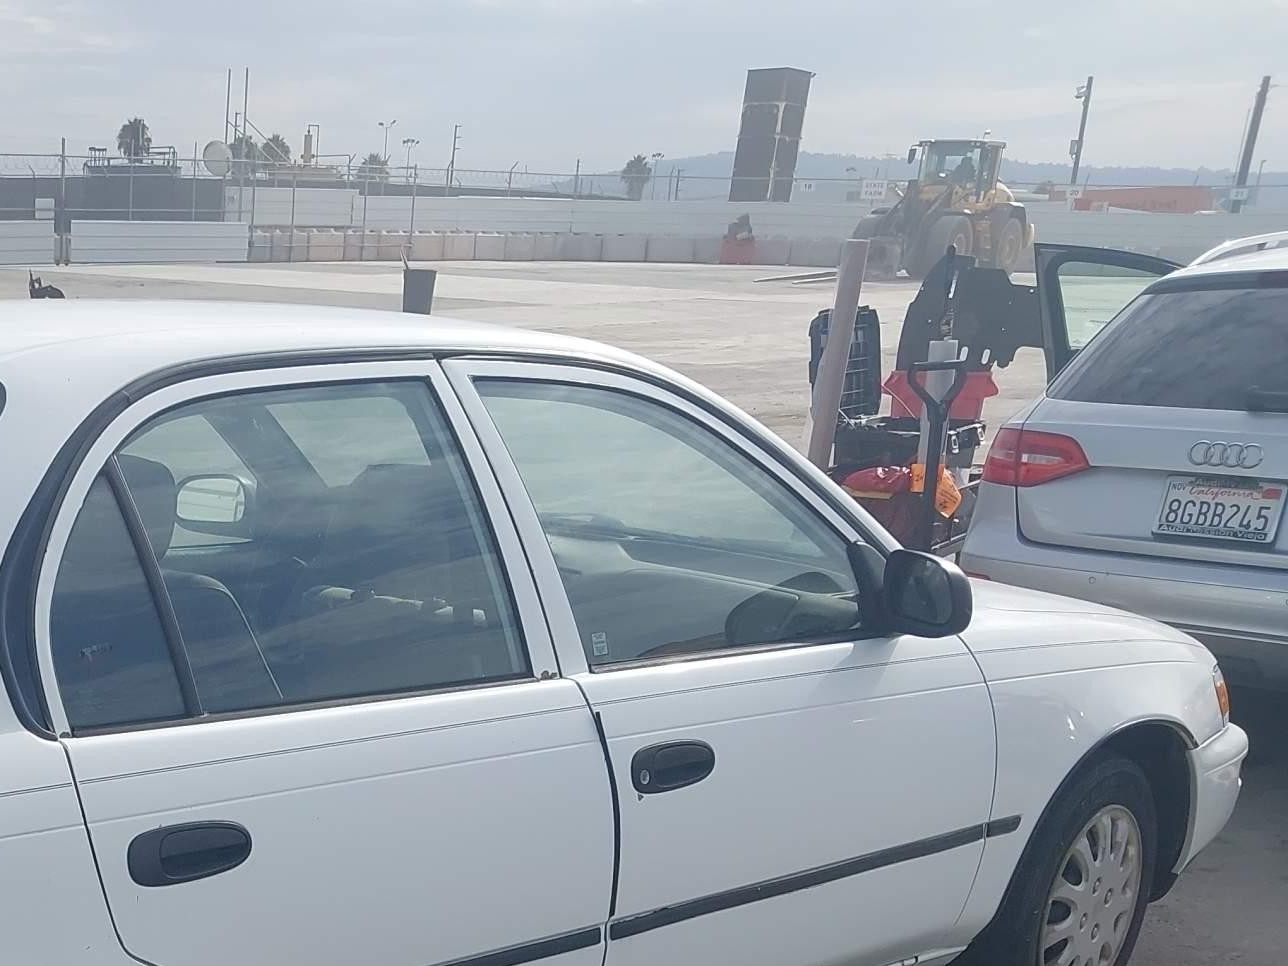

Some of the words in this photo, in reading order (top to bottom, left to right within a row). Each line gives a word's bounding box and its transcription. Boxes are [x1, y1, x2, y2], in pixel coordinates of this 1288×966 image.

[1171, 482, 1187, 492] NOV
[1188, 486, 1259, 501] California
[1165, 498, 1272, 532] 8GBB245
